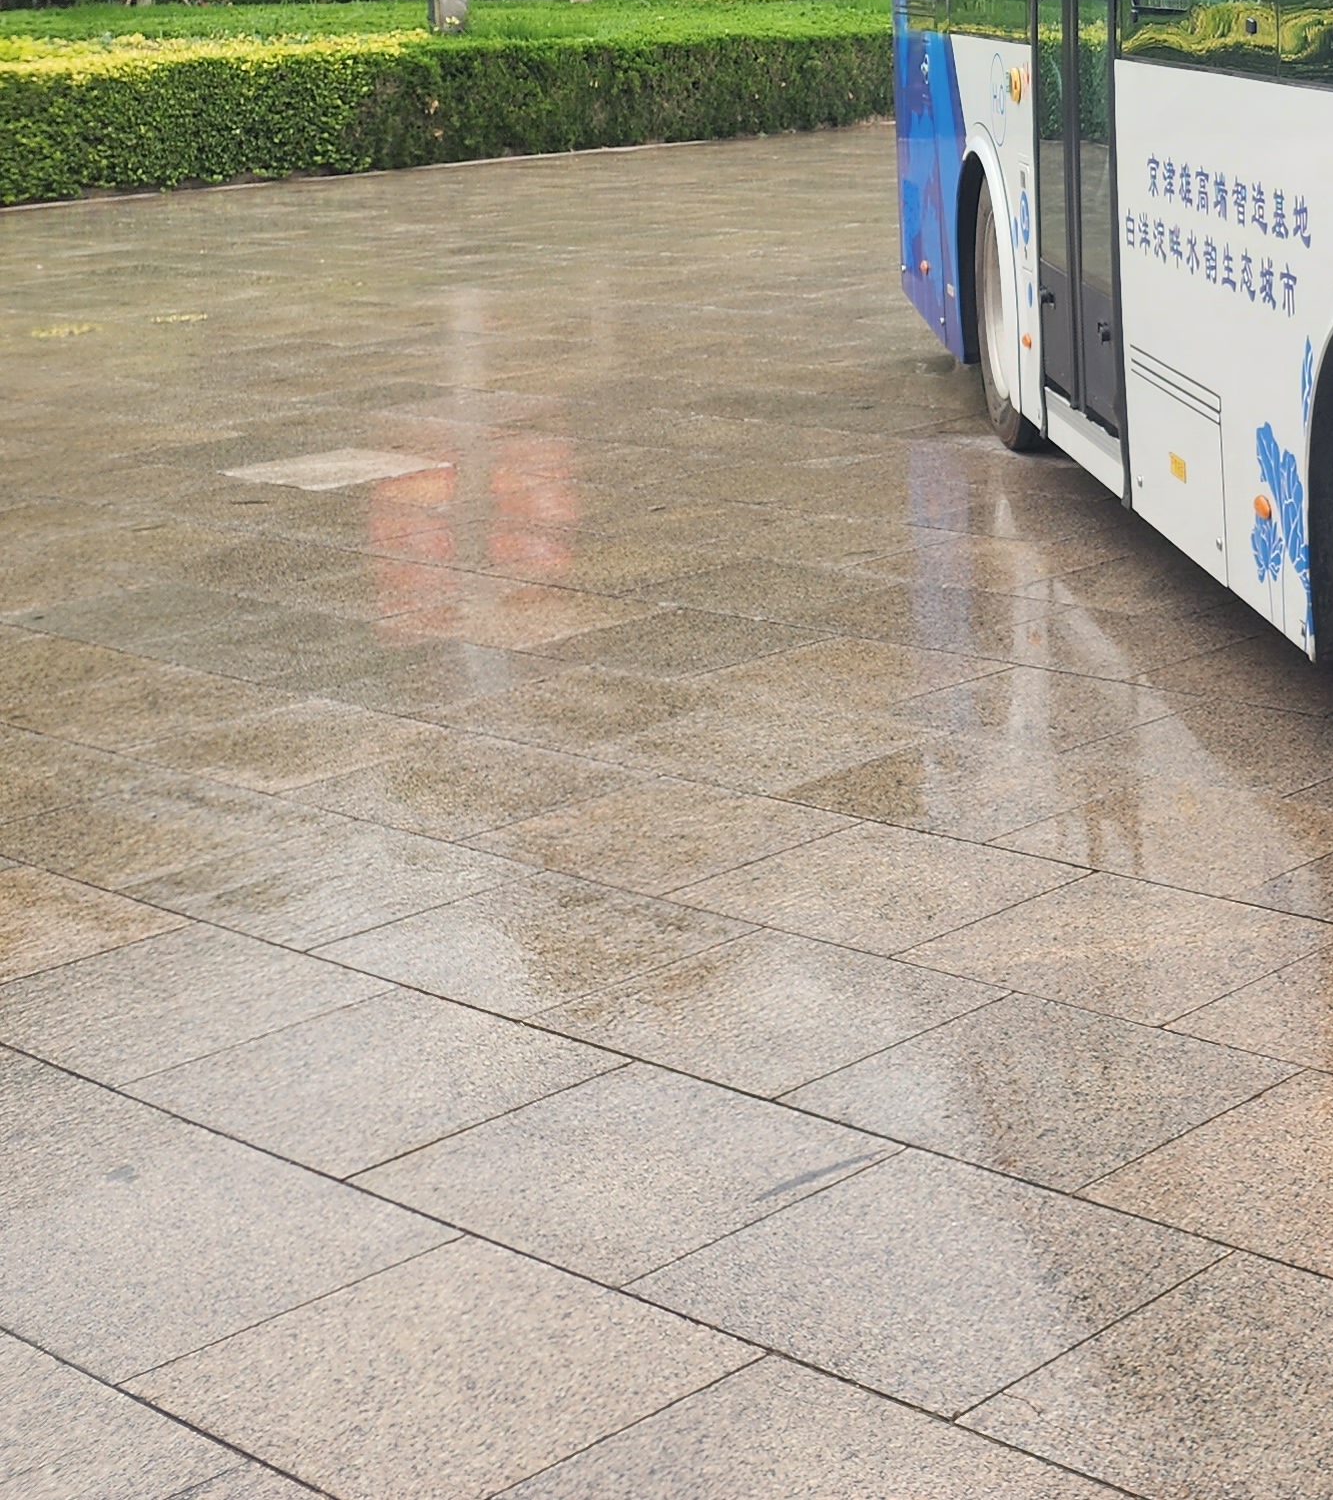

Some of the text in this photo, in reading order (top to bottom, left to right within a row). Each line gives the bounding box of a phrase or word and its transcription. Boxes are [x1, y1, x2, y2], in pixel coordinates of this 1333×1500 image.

[1147, 153, 1312, 249] 京津雄高端智造基地
[1125, 208, 1297, 318] 白洋淀畔水韵生态城市
